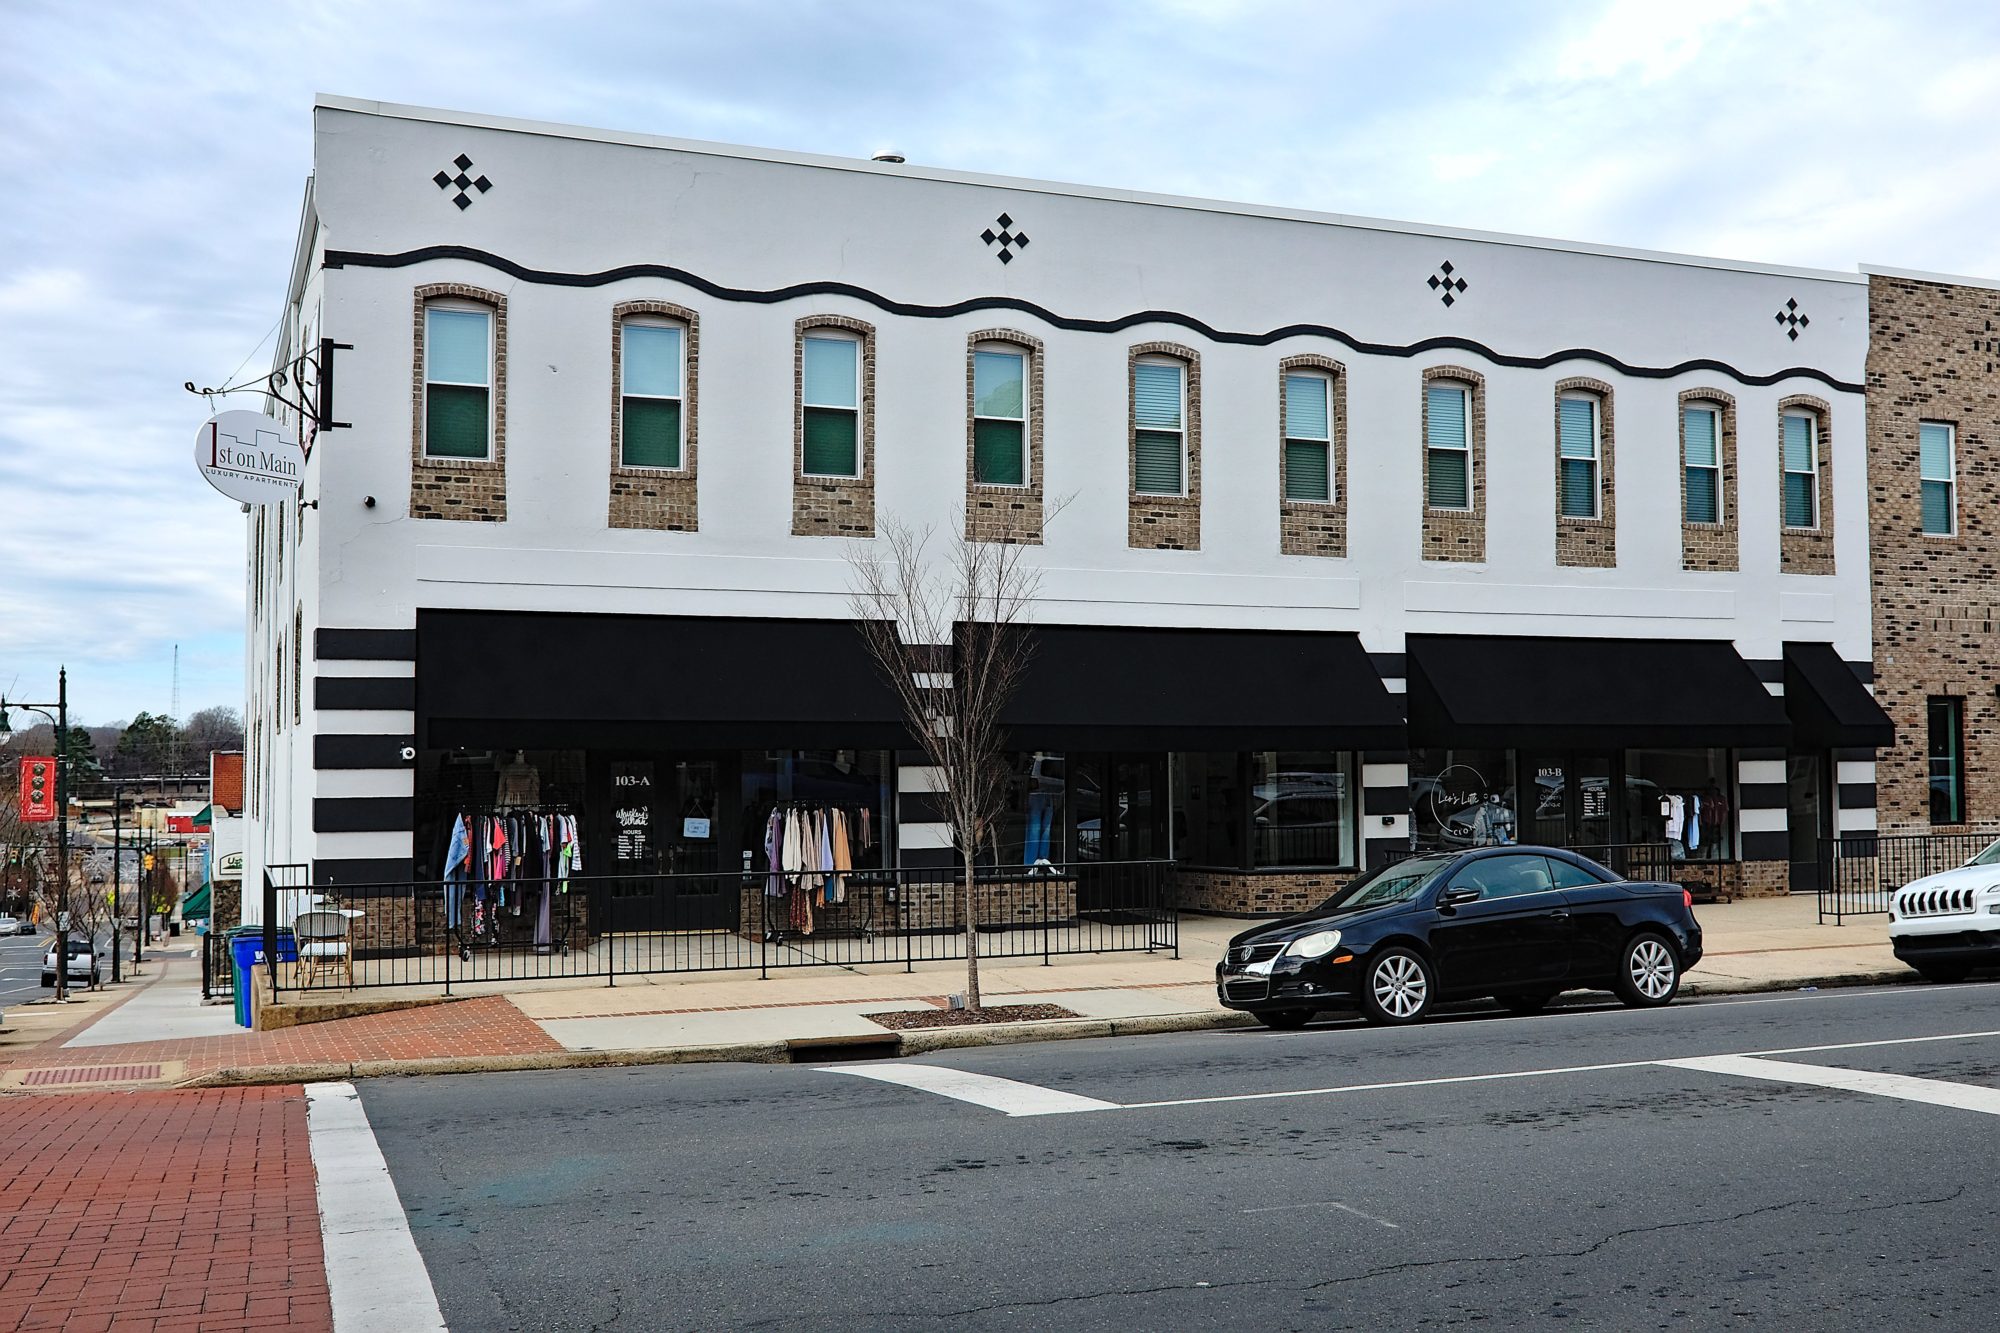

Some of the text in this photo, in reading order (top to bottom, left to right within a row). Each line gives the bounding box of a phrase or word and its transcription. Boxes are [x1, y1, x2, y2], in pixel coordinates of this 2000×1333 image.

[206, 422, 296, 476] 1st on Main
[205, 468, 298, 489] LUXURY APARTMENTS
[1538, 767, 1562, 777] 103-B
[615, 776, 650, 786] 103-A
